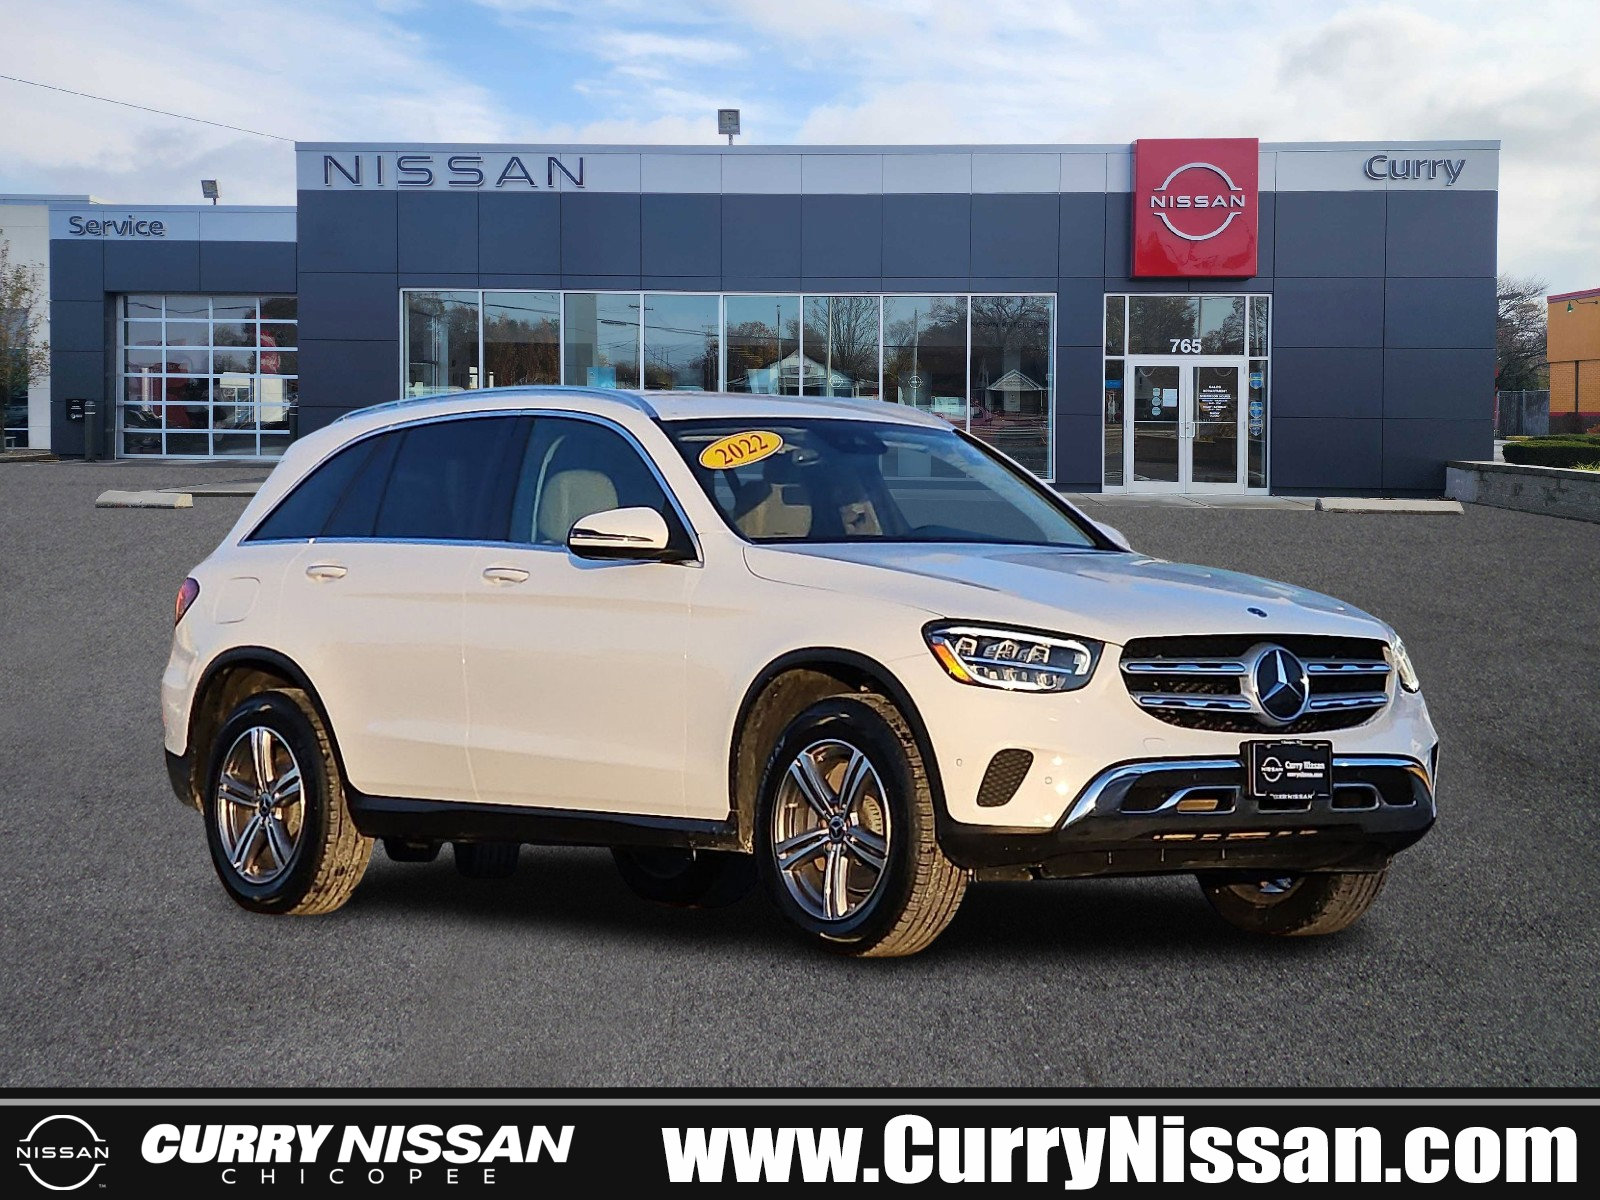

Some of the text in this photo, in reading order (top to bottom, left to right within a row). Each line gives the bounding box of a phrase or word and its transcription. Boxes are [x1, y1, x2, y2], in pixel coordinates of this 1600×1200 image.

[323, 154, 585, 188] NISSAN
[1364, 154, 1466, 186] Curry
[1150, 194, 1246, 209] NISSAN
[69, 214, 166, 238] Service
[1169, 339, 1202, 354] 765
[715, 435, 768, 465] 2022
[1284, 760, 1303, 771] Curry
